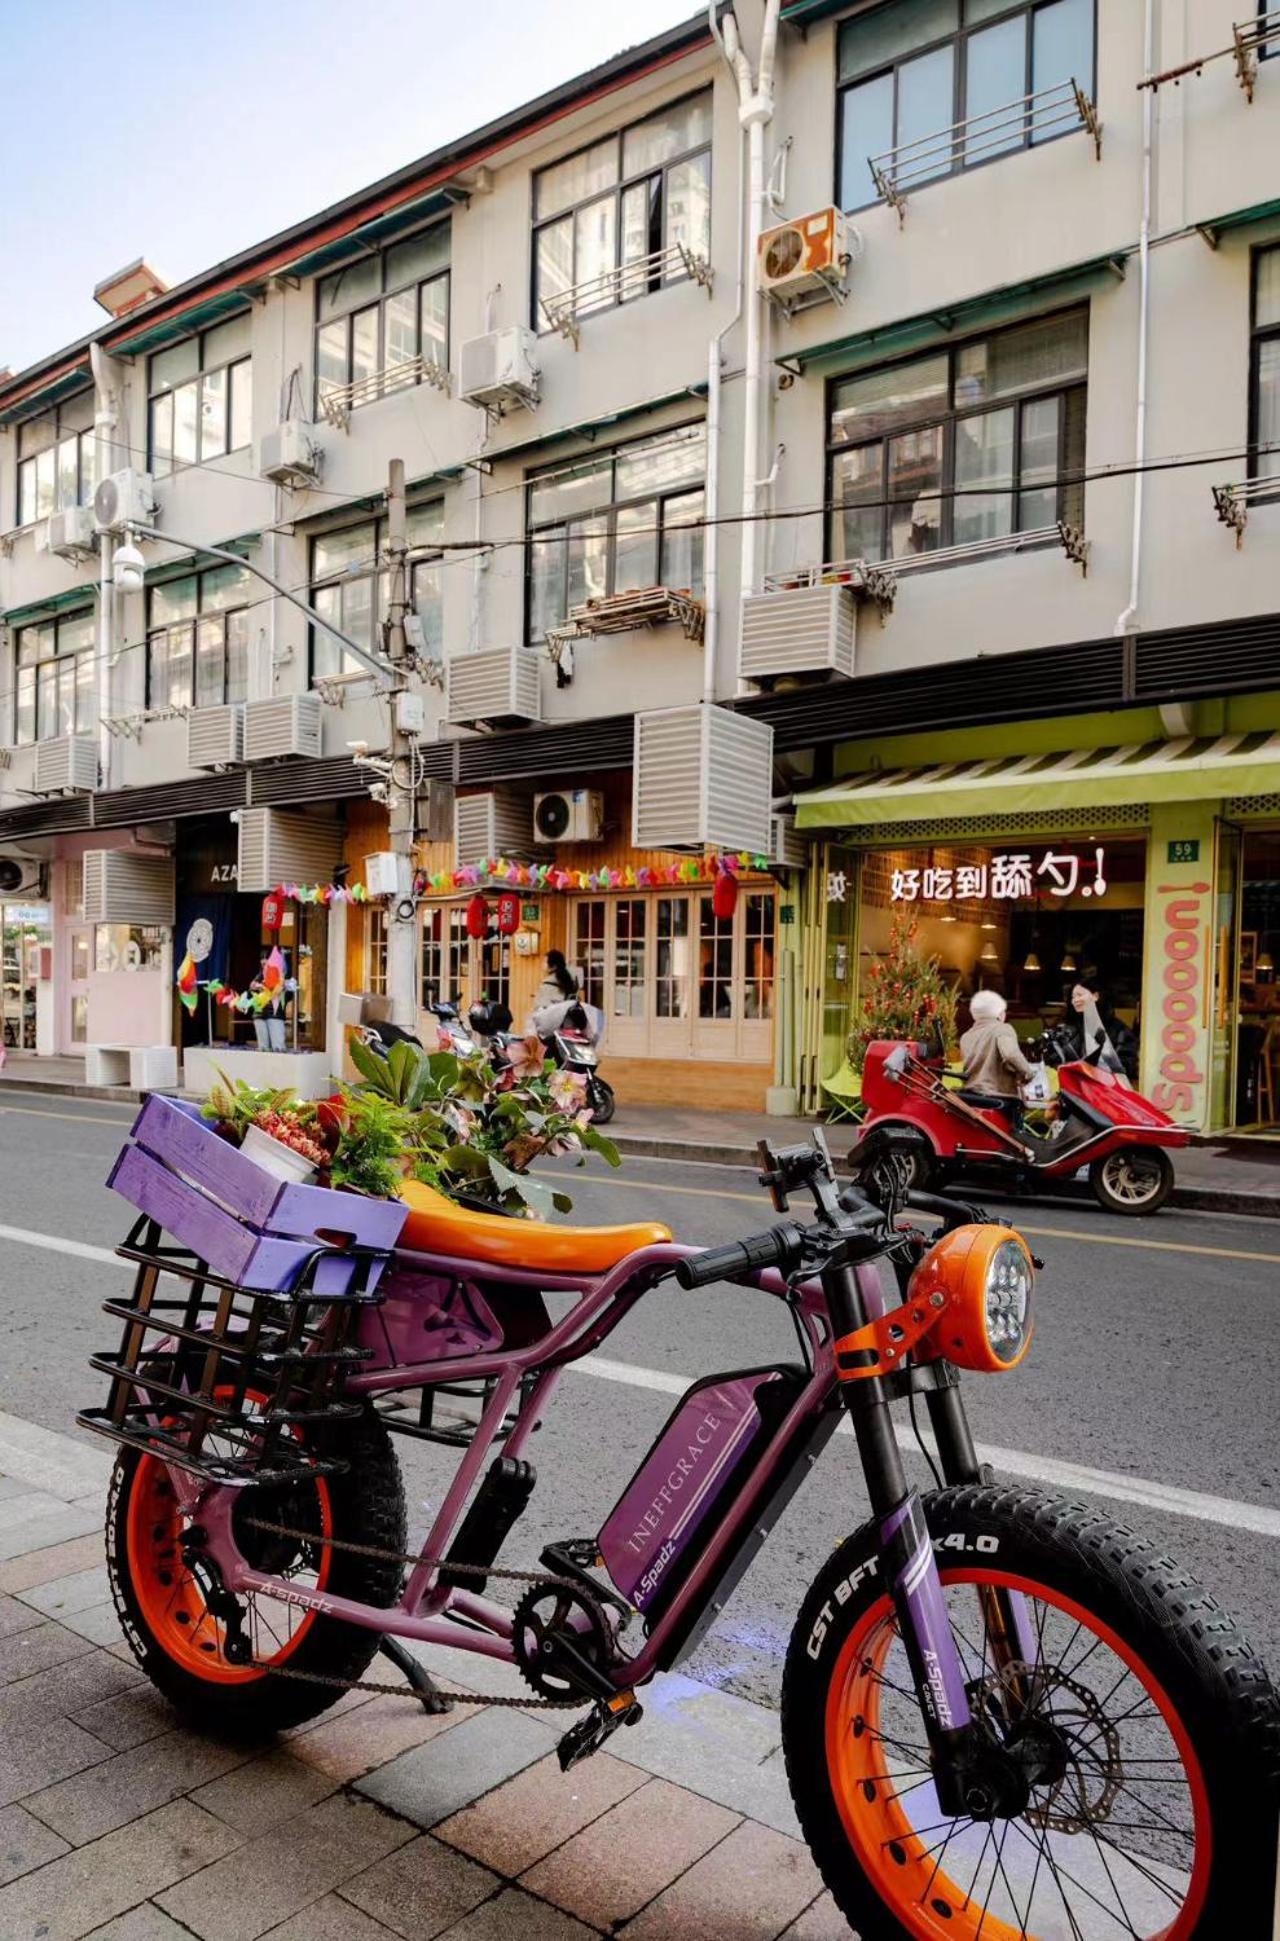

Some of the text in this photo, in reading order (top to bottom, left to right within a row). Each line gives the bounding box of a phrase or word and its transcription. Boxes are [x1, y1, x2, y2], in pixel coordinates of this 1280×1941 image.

[628, 1411, 721, 1554] INEFFGRACE
[806, 1599, 835, 1661] CST
[832, 1554, 881, 1607] BFT
